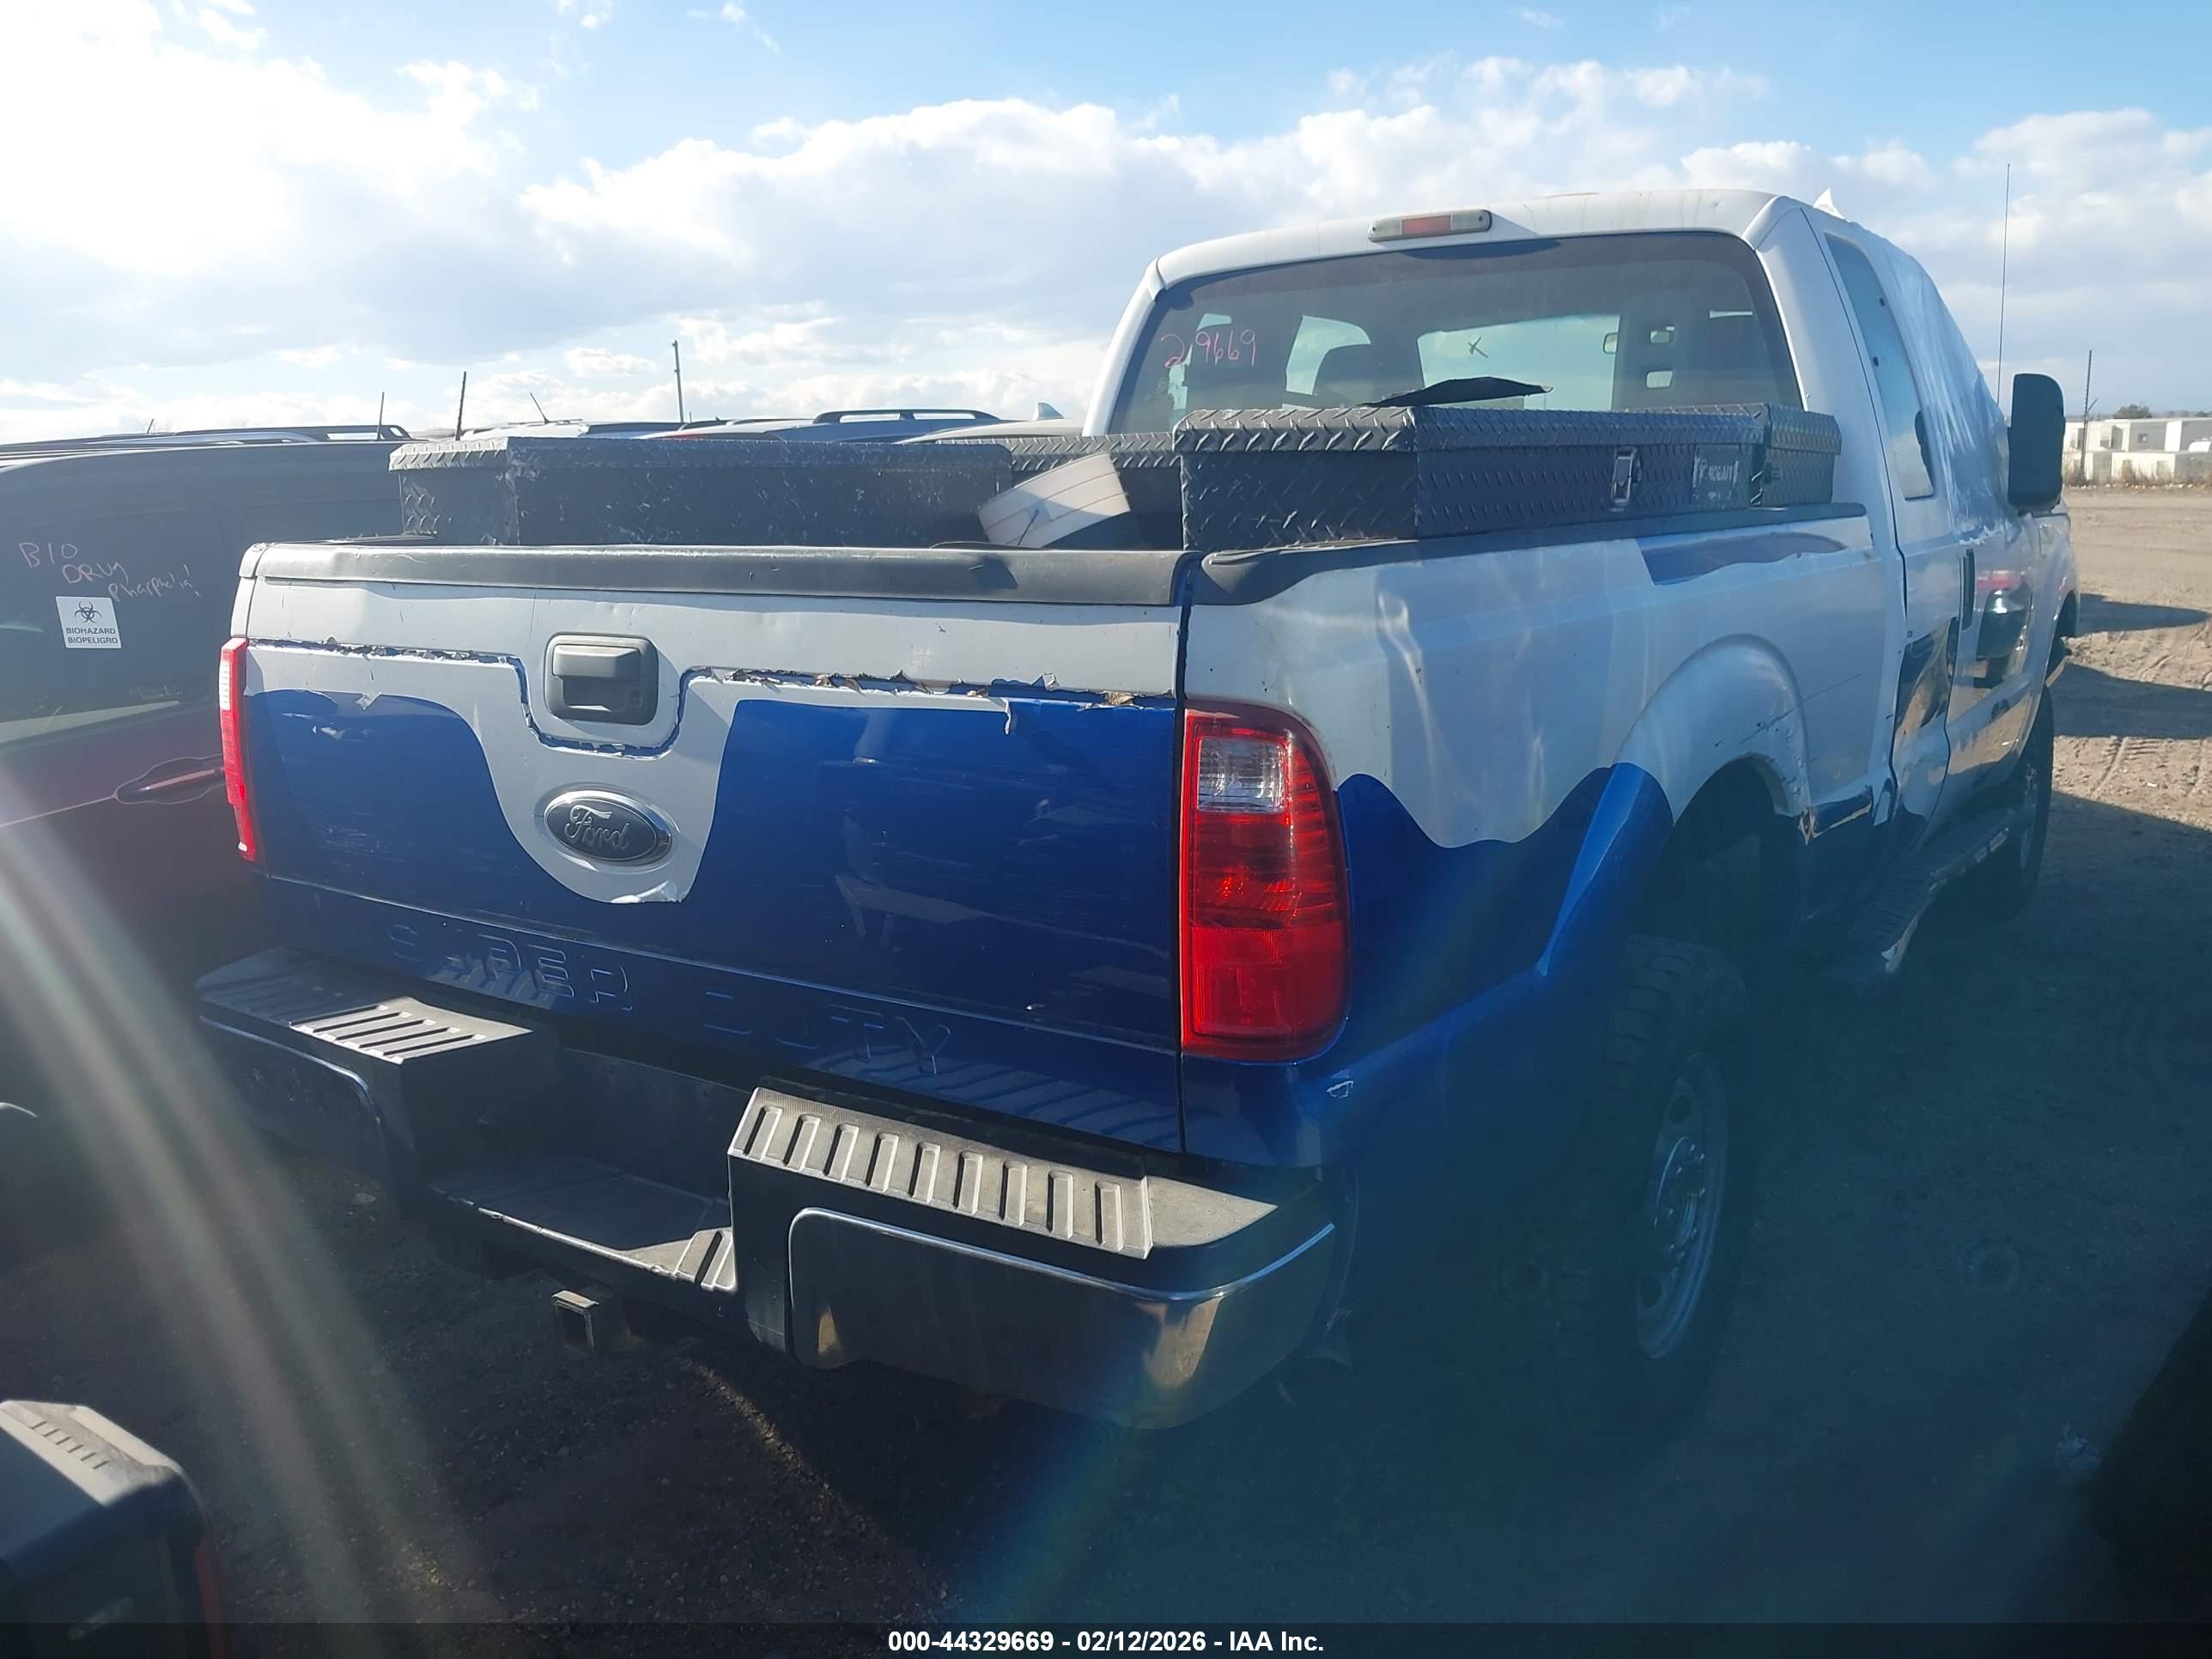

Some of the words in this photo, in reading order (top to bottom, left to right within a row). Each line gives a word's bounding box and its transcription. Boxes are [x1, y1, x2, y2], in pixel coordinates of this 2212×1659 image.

[1161, 328, 1256, 368] 29669
[66, 627, 116, 635] BIOHAZARD
[68, 636, 118, 645] BIOPELIGRO
[563, 804, 631, 851] Ford
